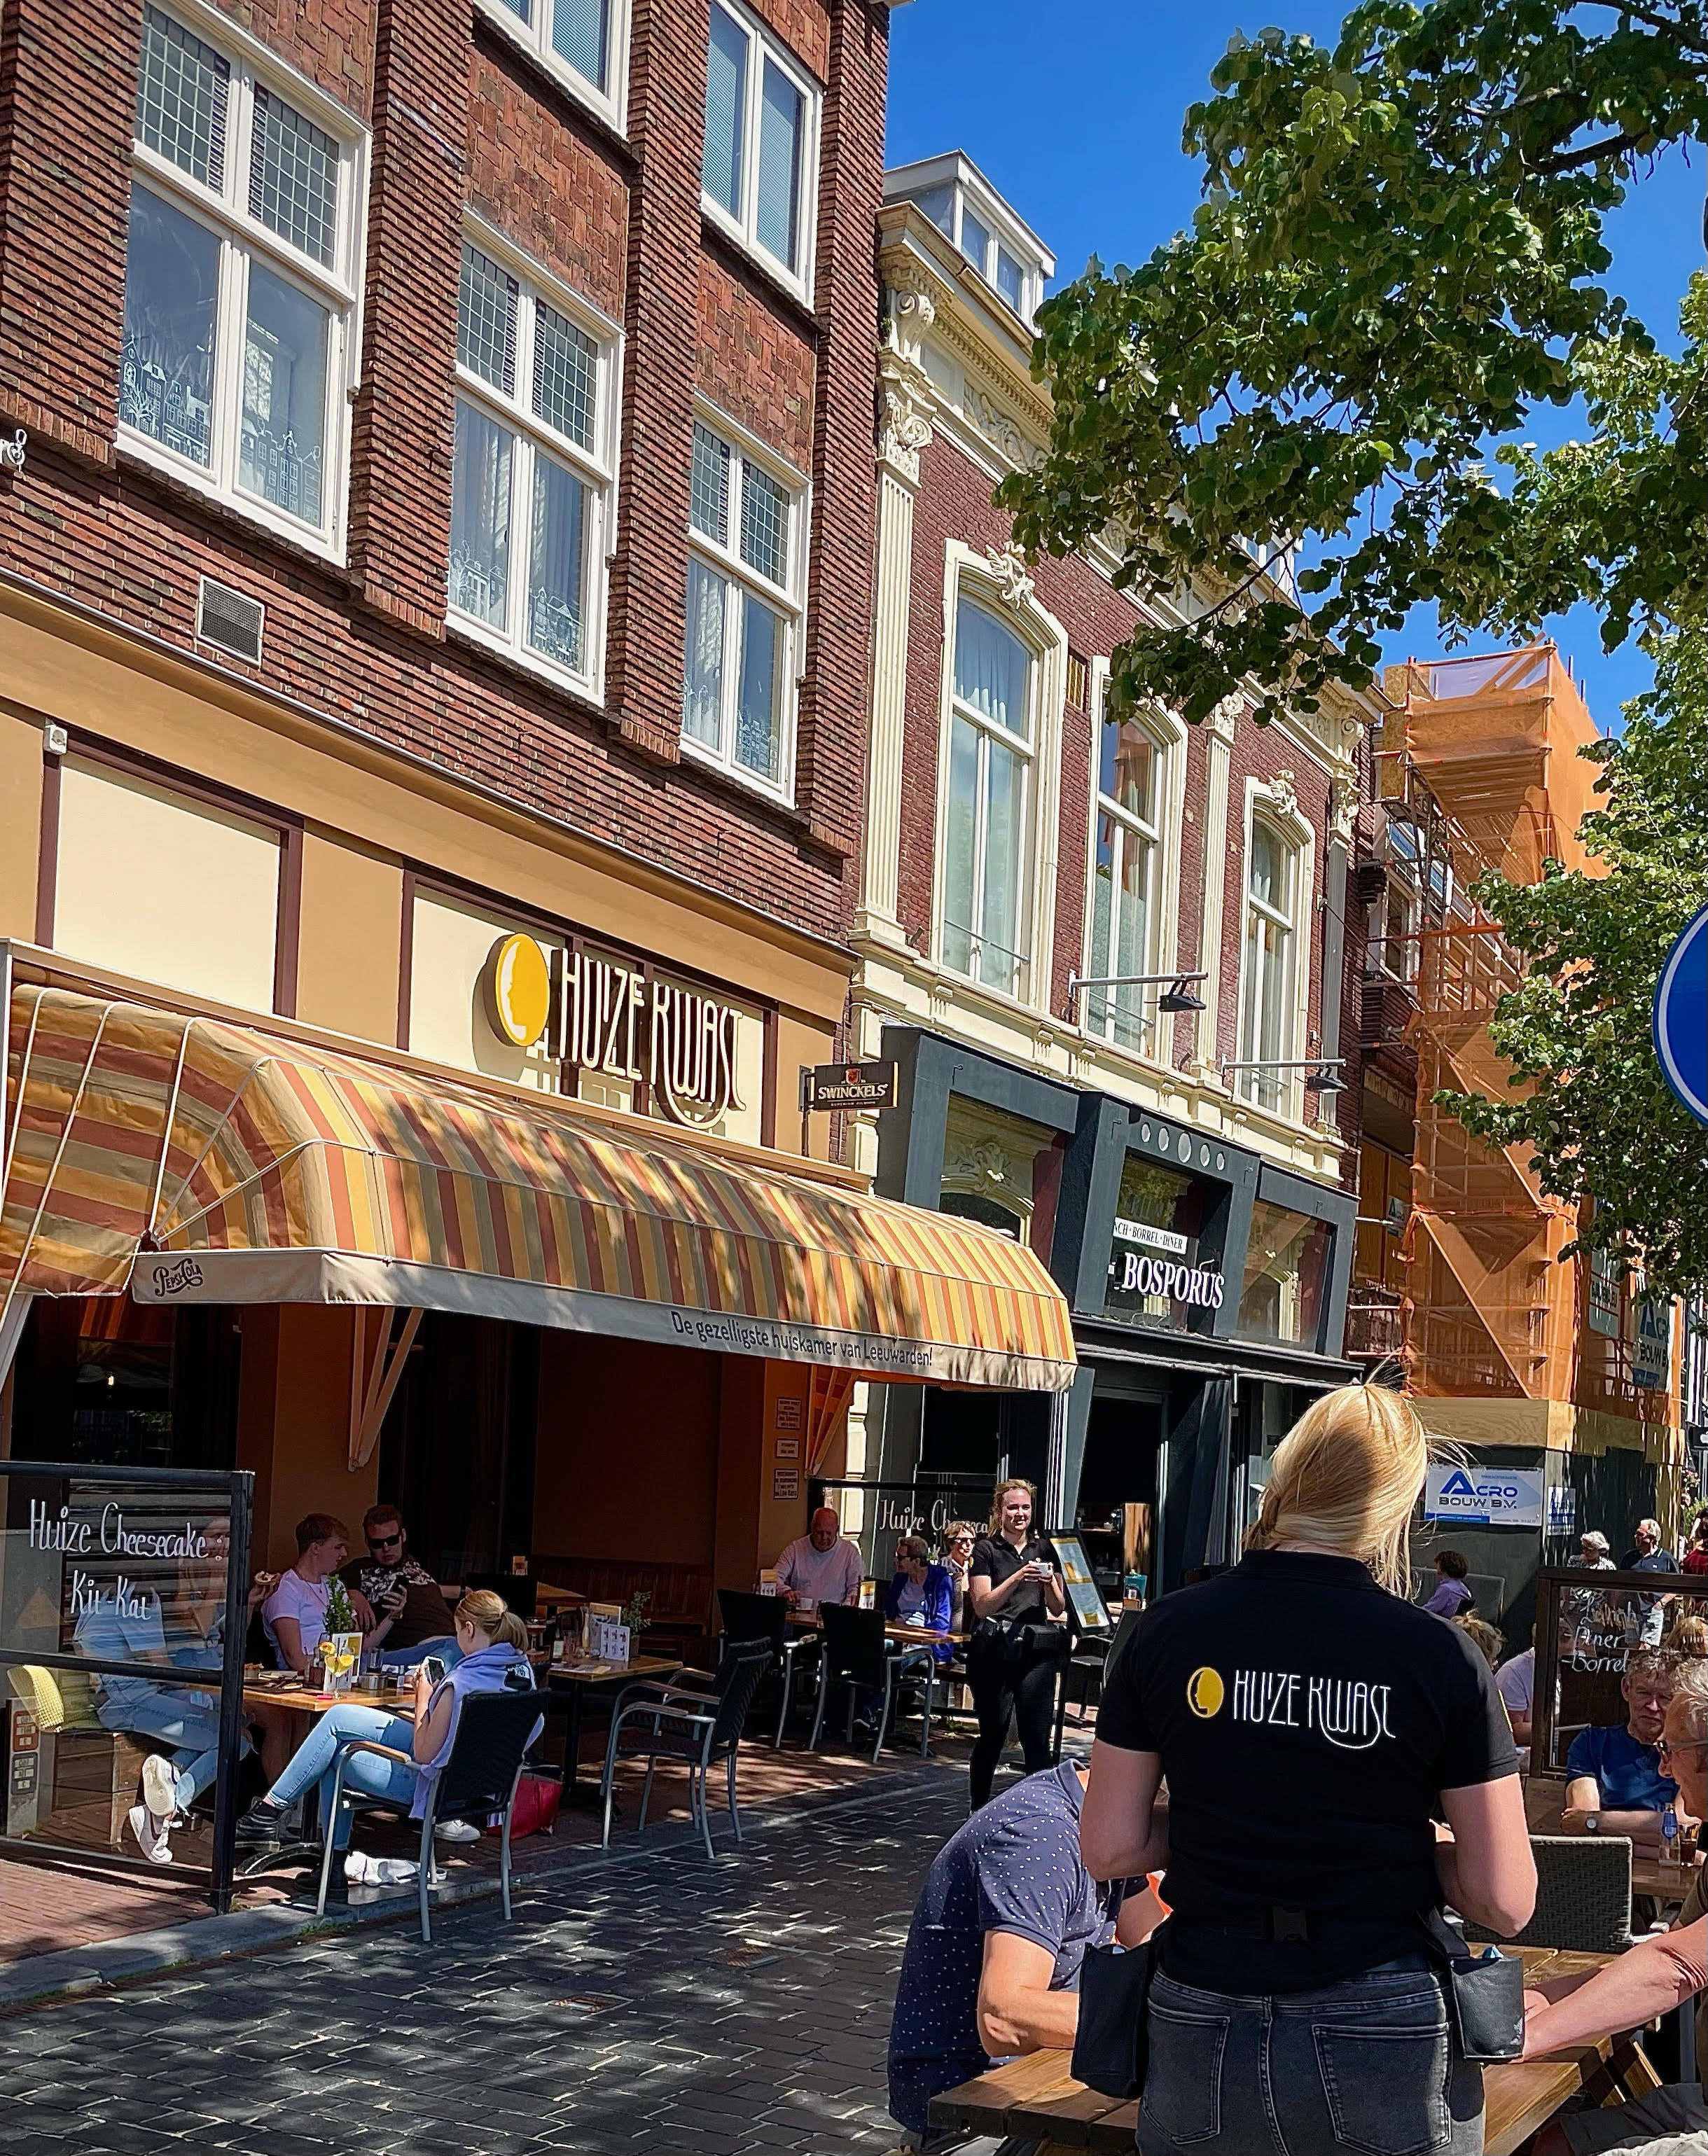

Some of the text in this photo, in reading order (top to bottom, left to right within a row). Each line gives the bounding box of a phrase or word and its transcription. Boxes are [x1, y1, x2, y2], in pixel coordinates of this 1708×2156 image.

[559, 947, 747, 1129] HUIZE KWAST
[1132, 1226, 1159, 1244] BORREL
[1163, 1235, 1183, 1250] DINER
[1122, 1252, 1225, 1309] BOSPORUS
[671, 1311, 933, 1367] De gezelligste huiskamer van Leeuwarden!
[1439, 1497, 1518, 1509] BOUW B.V.
[1440, 1470, 1518, 1497] ACRO
[29, 1498, 91, 1553] Huize
[879, 1498, 924, 1531] Huize
[1233, 1669, 1396, 1749] HUIZE KWAST
